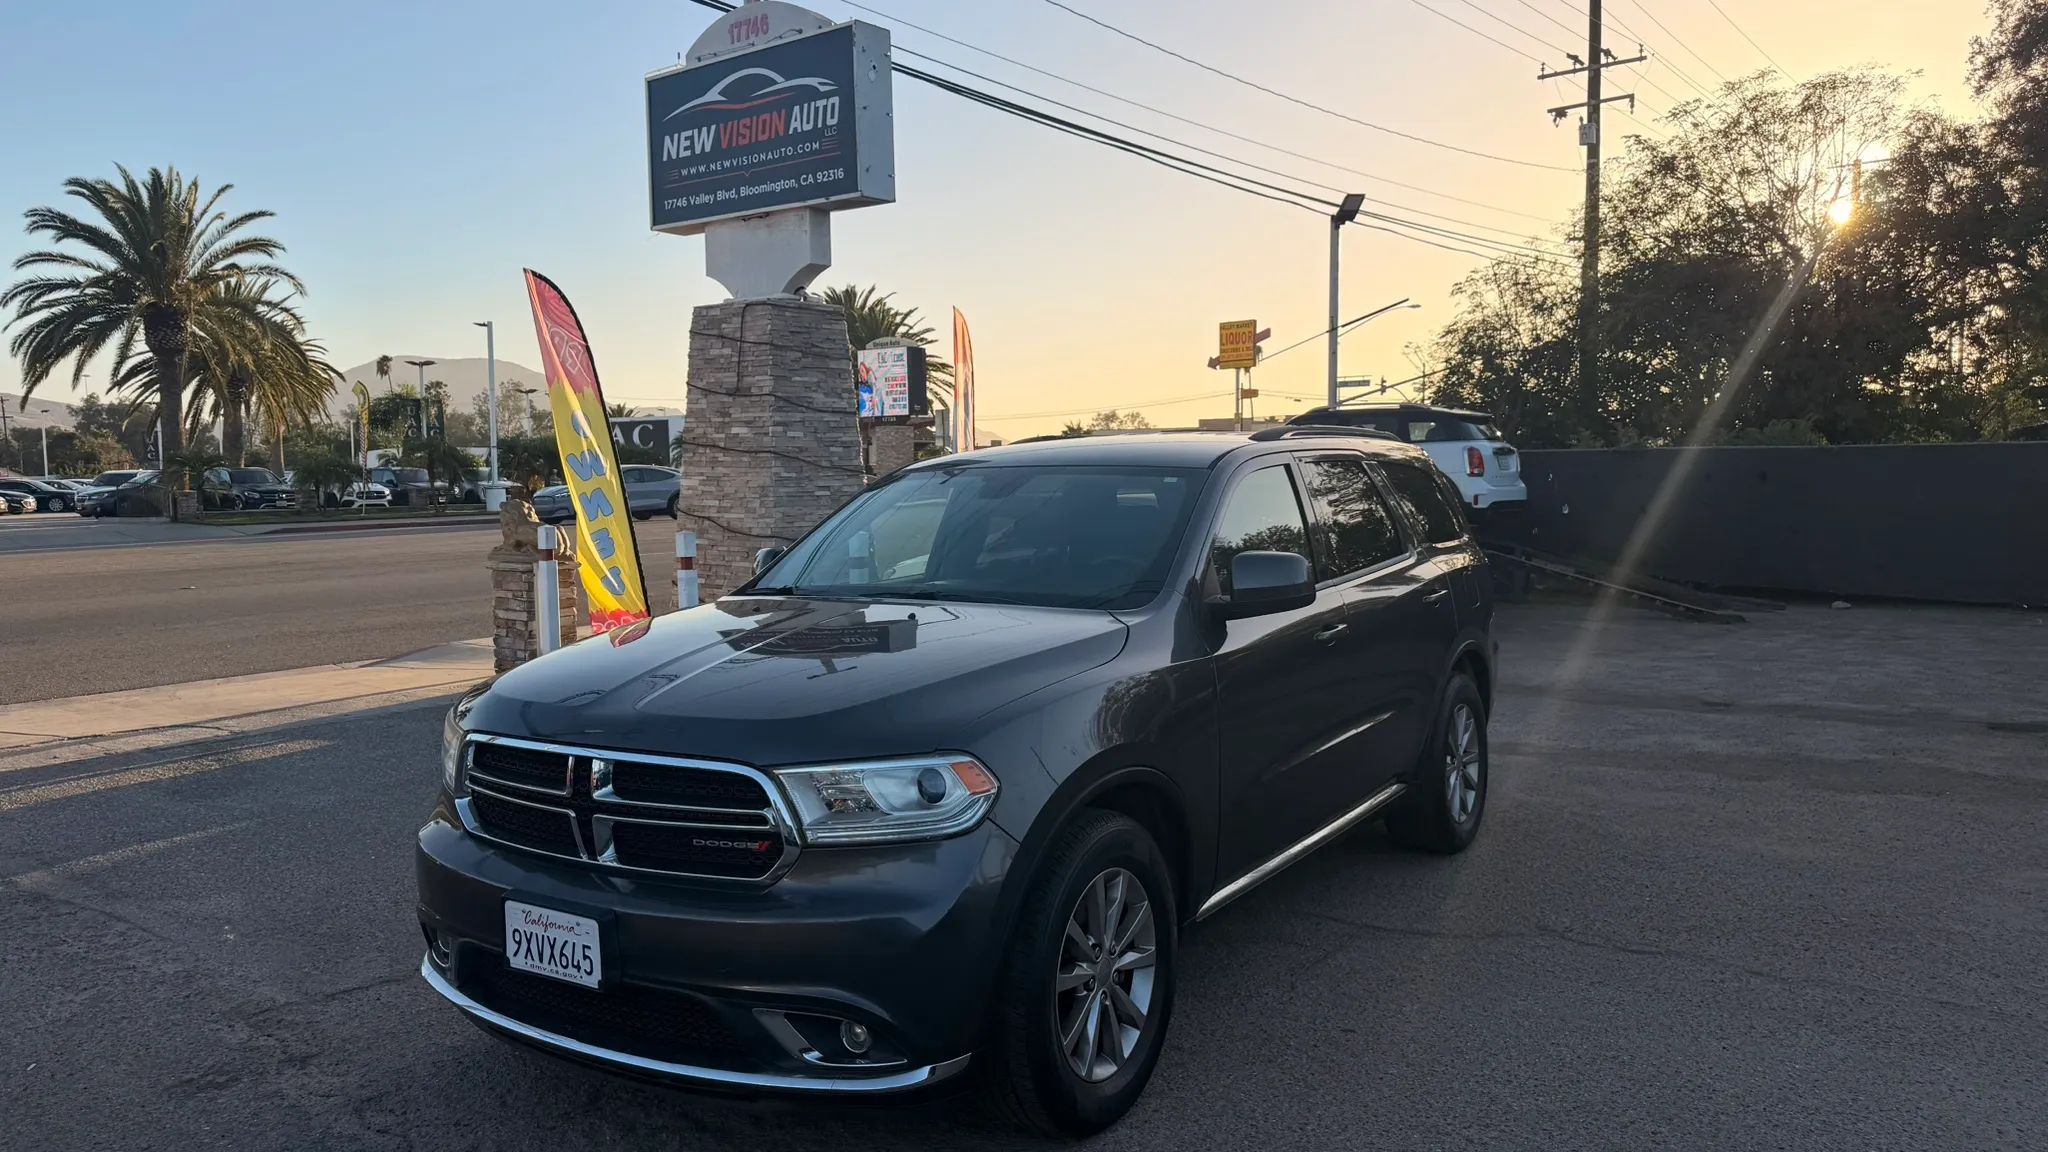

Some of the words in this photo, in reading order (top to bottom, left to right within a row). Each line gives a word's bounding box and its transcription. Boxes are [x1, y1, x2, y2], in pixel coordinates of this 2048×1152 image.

[728, 14, 769, 44] 17746
[663, 124, 717, 161] NEW
[720, 109, 786, 150] VISION
[788, 96, 840, 135] AUTO
[824, 126, 838, 137] LLC
[680, 141, 820, 177] WWW.NEWVISIONAUTO.COM
[664, 196, 688, 210] 17746
[689, 192, 716, 205] Valley
[716, 187, 739, 201] Blvd,
[740, 179, 799, 197] Bloomington,
[800, 173, 815, 186] CA
[816, 167, 845, 183] 92316
[693, 839, 759, 849] DODGE
[524, 910, 582, 936] California
[512, 927, 594, 976] 9XVX645
